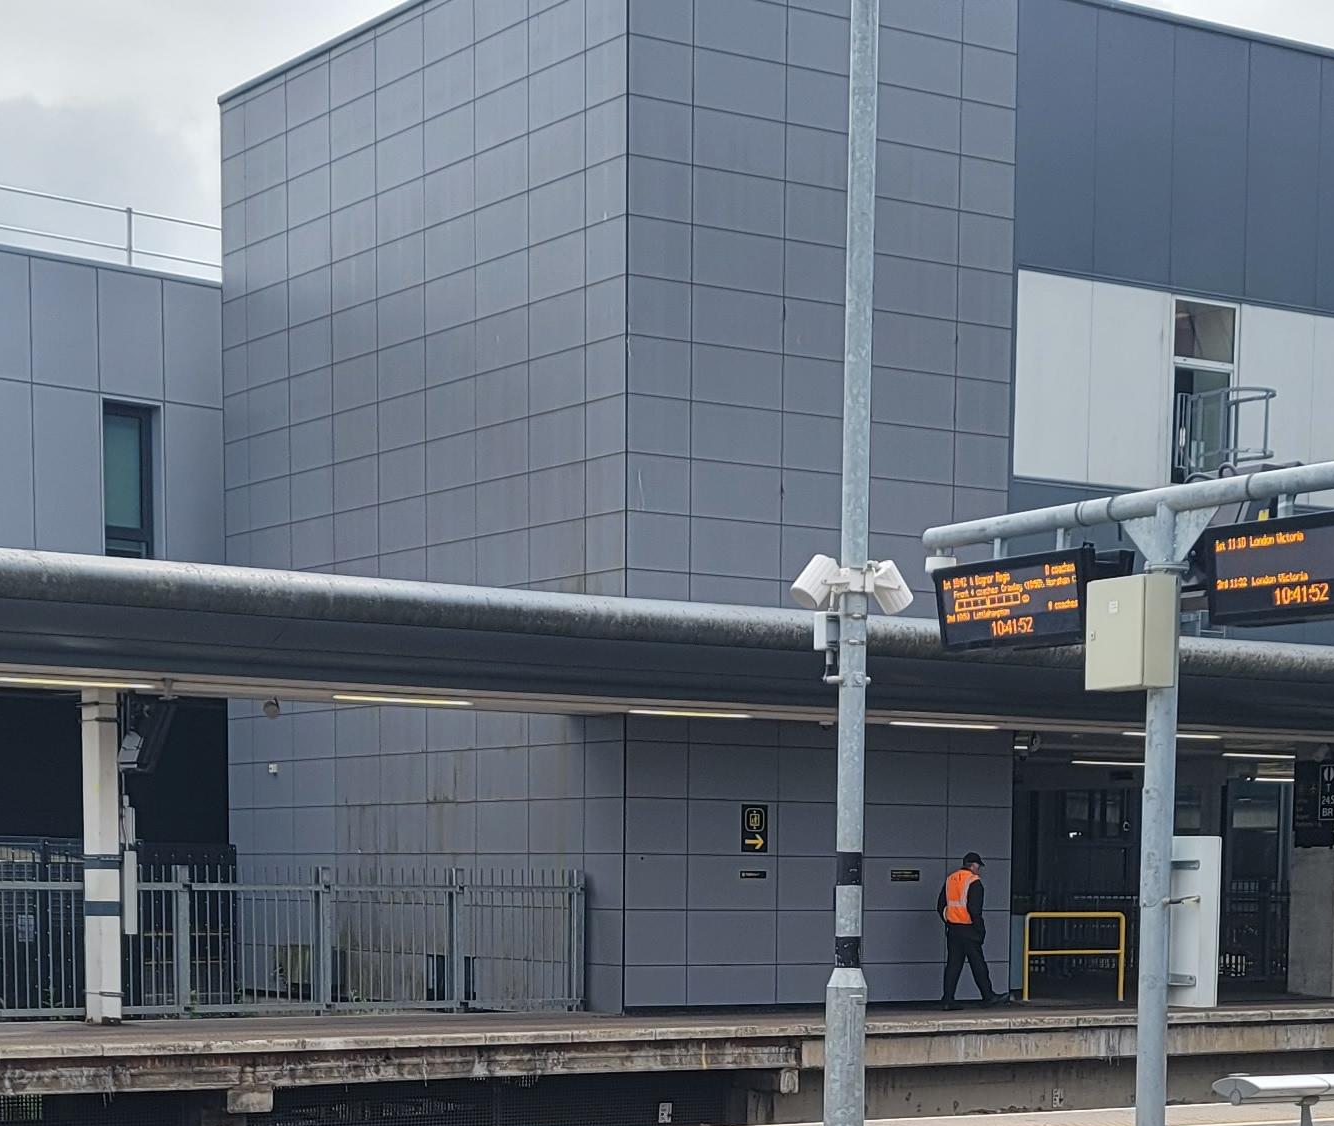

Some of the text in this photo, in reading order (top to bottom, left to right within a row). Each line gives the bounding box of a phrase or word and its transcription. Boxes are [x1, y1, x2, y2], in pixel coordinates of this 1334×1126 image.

[1249, 534, 1275, 548] London
[1276, 531, 1305, 545] Victoria
[1251, 574, 1276, 587] London
[1278, 571, 1309, 584] Victoria
[1274, 582, 1330, 606] 10:41:52
[991, 616, 1035, 637] 10:41:52
[1322, 807, 1333, 817] BR
